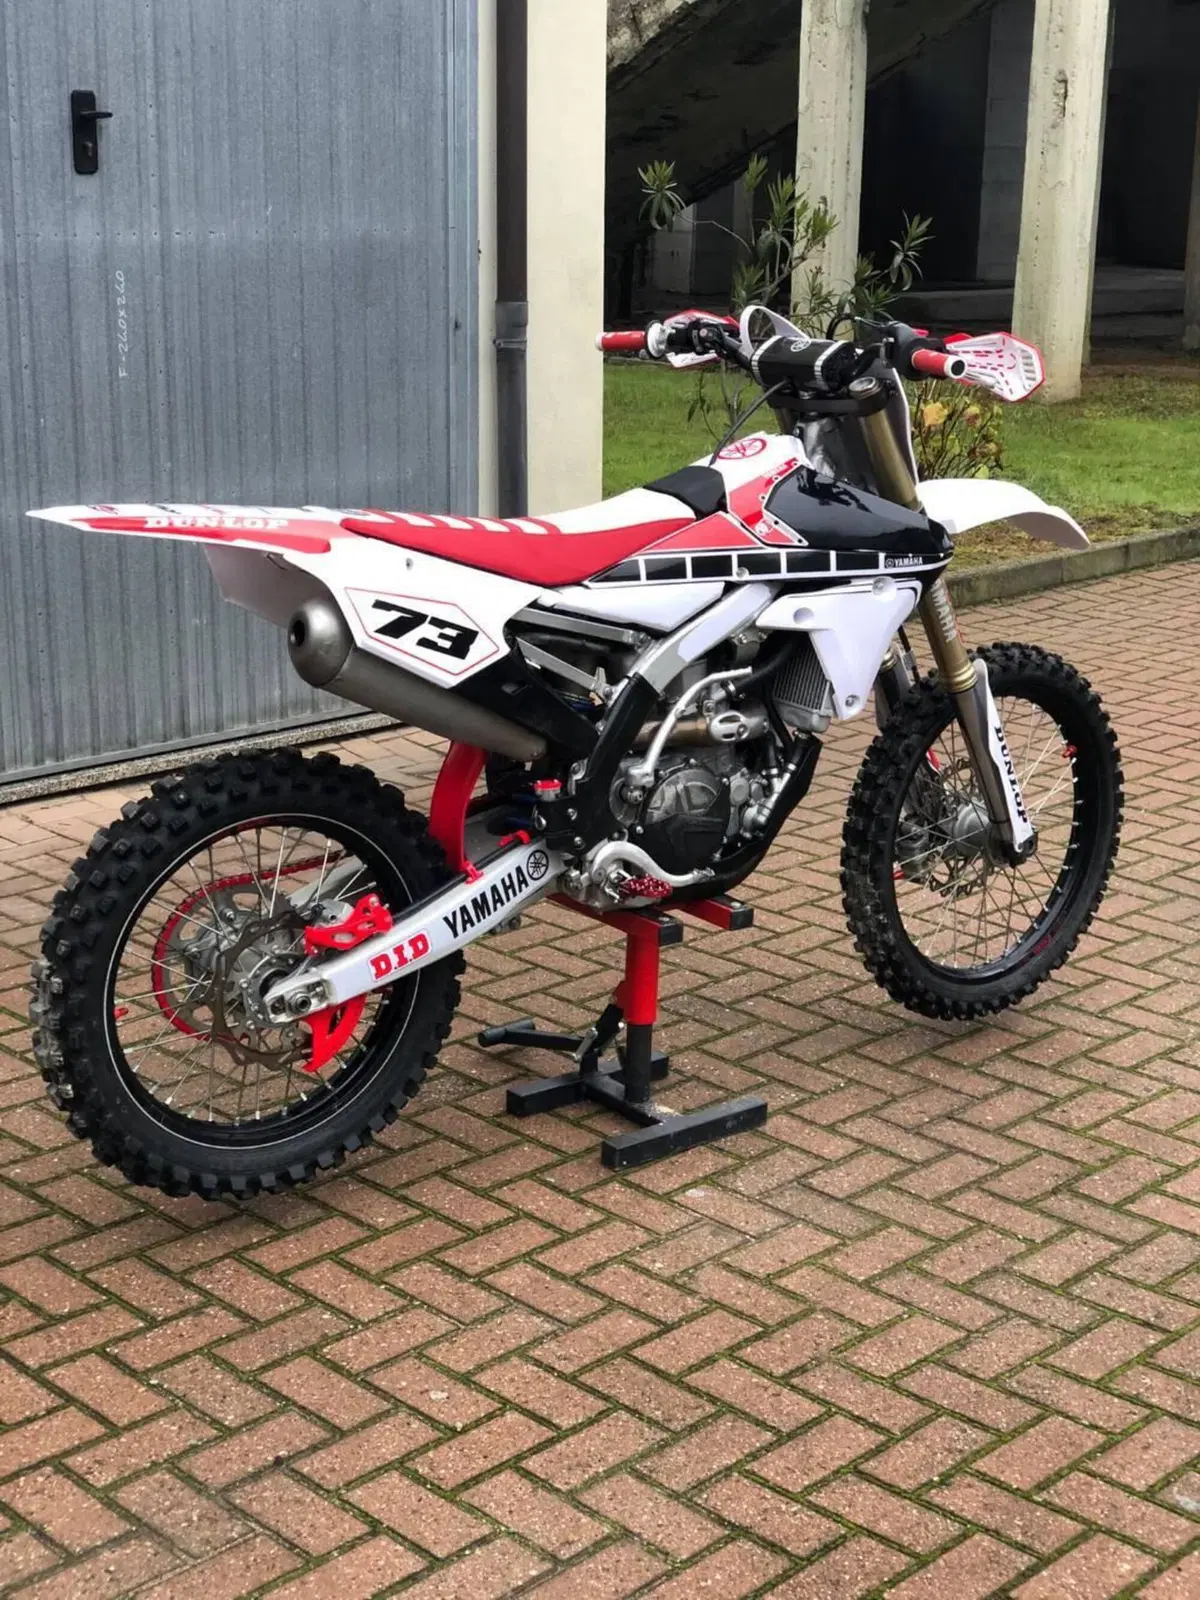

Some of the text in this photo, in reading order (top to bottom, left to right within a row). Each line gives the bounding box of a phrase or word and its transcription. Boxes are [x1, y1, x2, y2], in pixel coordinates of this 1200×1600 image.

[143, 515, 288, 530] DUNLOP
[895, 557, 923, 567] YAMAHA
[371, 598, 479, 661] 73
[931, 580, 957, 642] AMAHA
[994, 726, 1028, 824] DUNLOP
[442, 864, 530, 939] YAMAHA
[369, 933, 430, 980] D.I.D
